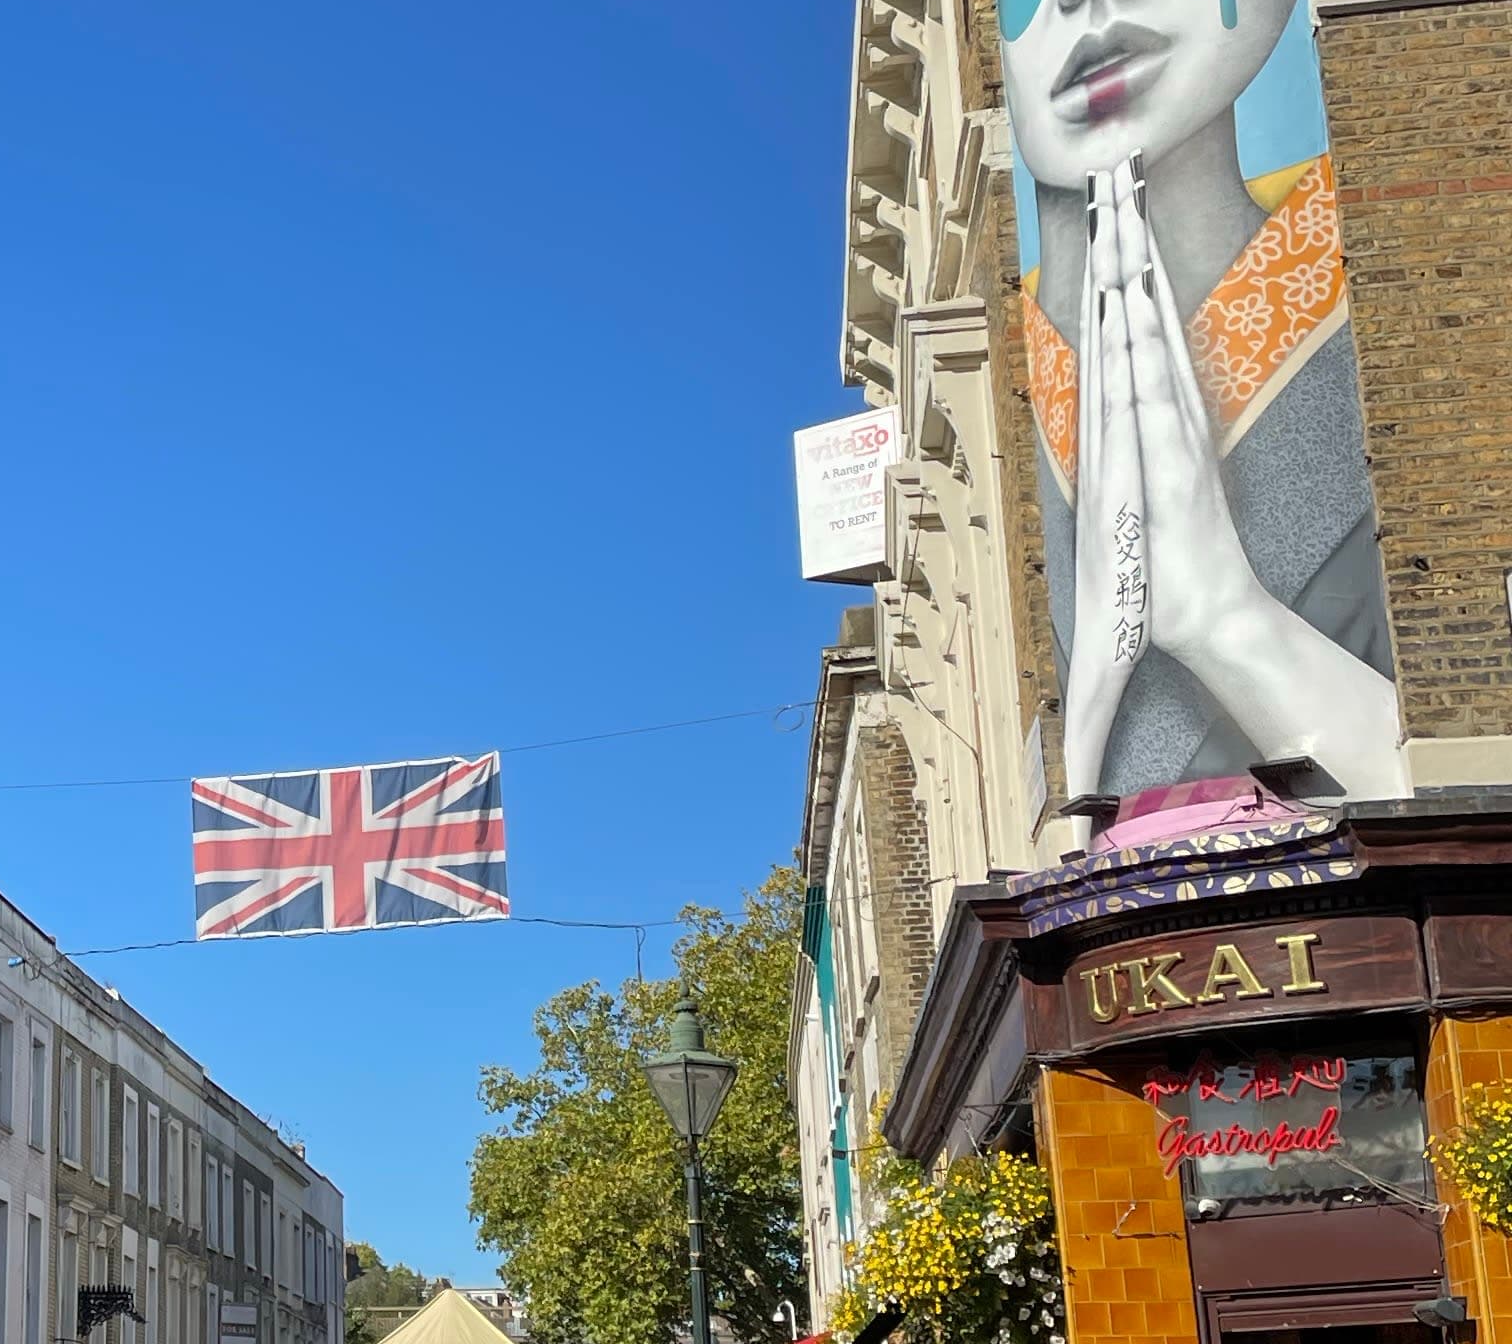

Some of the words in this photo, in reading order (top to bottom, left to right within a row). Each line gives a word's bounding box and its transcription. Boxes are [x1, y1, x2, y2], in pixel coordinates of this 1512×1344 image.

[822, 471, 831, 480] A
[833, 463, 866, 478] Range
[868, 458, 878, 468] of
[829, 519, 845, 531] TO
[848, 512, 877, 527] RENT
[1079, 933, 1329, 1024] UKAI
[1158, 1106, 1342, 1179] Gastropub
